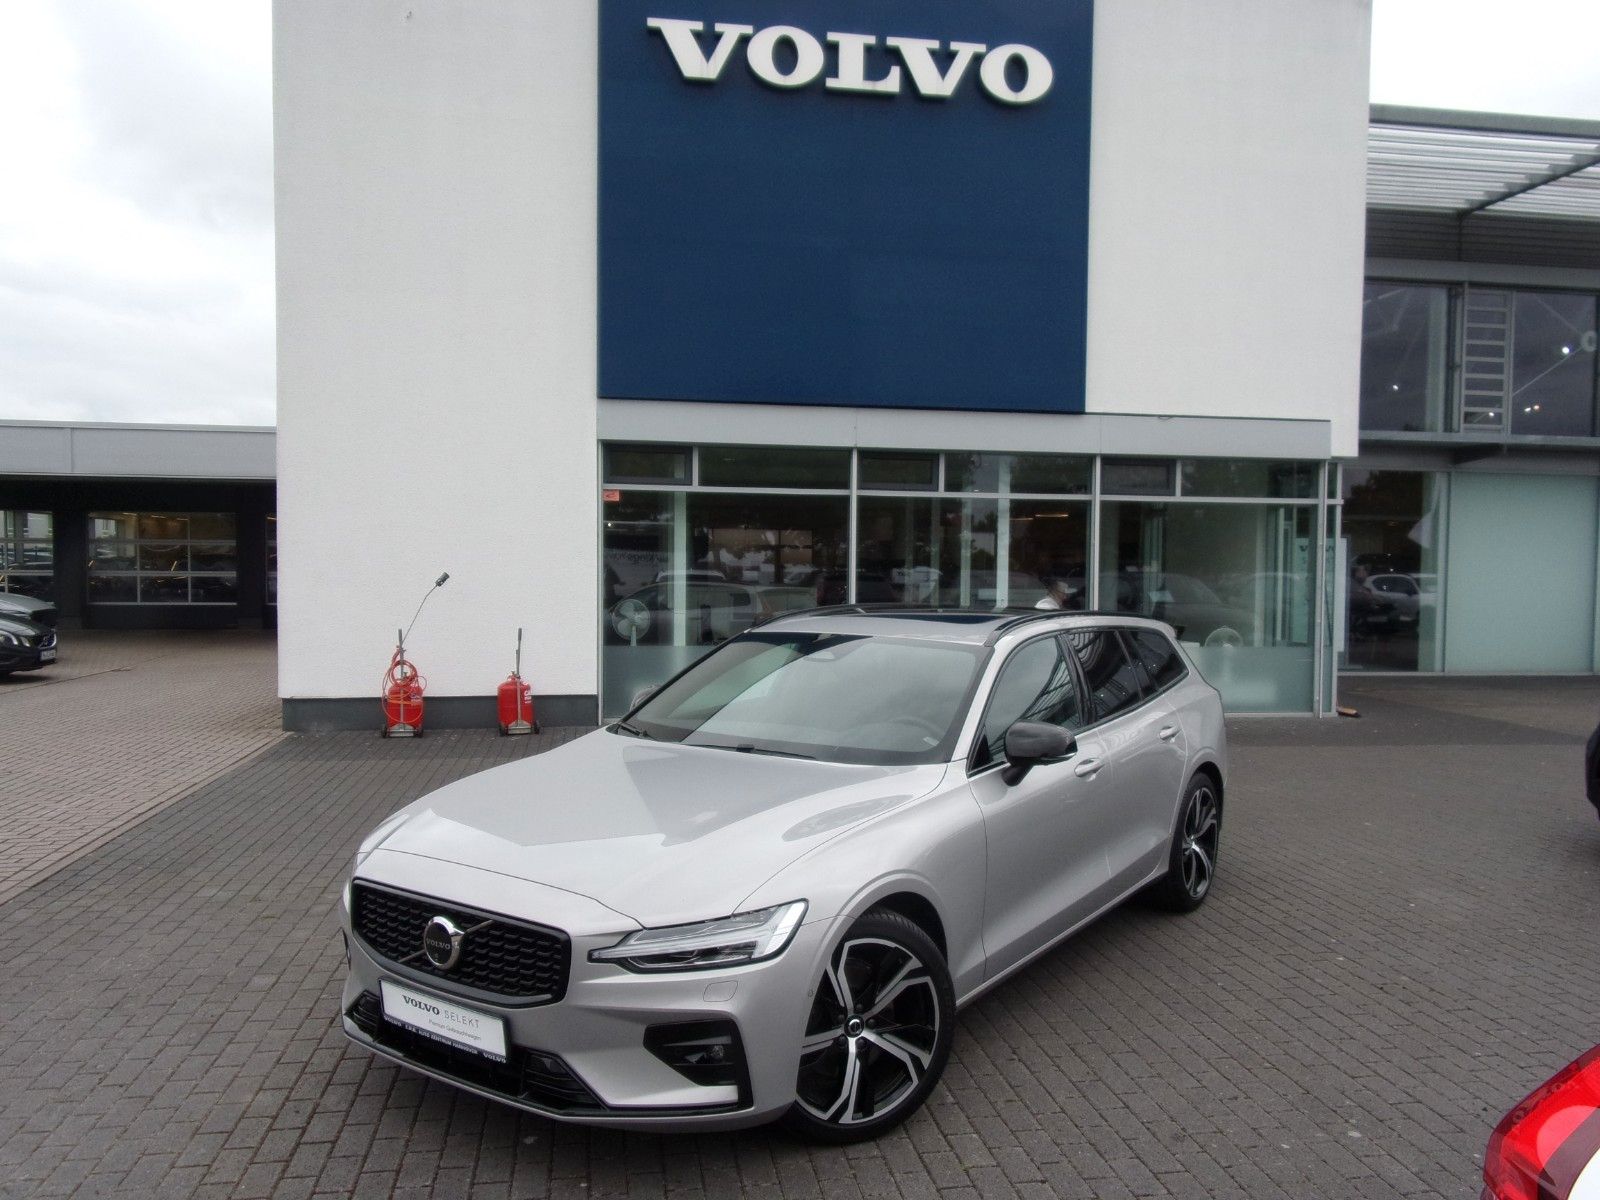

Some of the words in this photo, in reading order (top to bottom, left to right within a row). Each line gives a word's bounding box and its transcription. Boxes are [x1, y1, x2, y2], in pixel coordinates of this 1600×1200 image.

[647, 17, 1053, 104] VOLVO
[426, 938, 451, 950] VOLVO
[402, 995, 440, 1015] VOLVO
[444, 1010, 480, 1028] SELEKT
[483, 1052, 507, 1064] VOLVO
